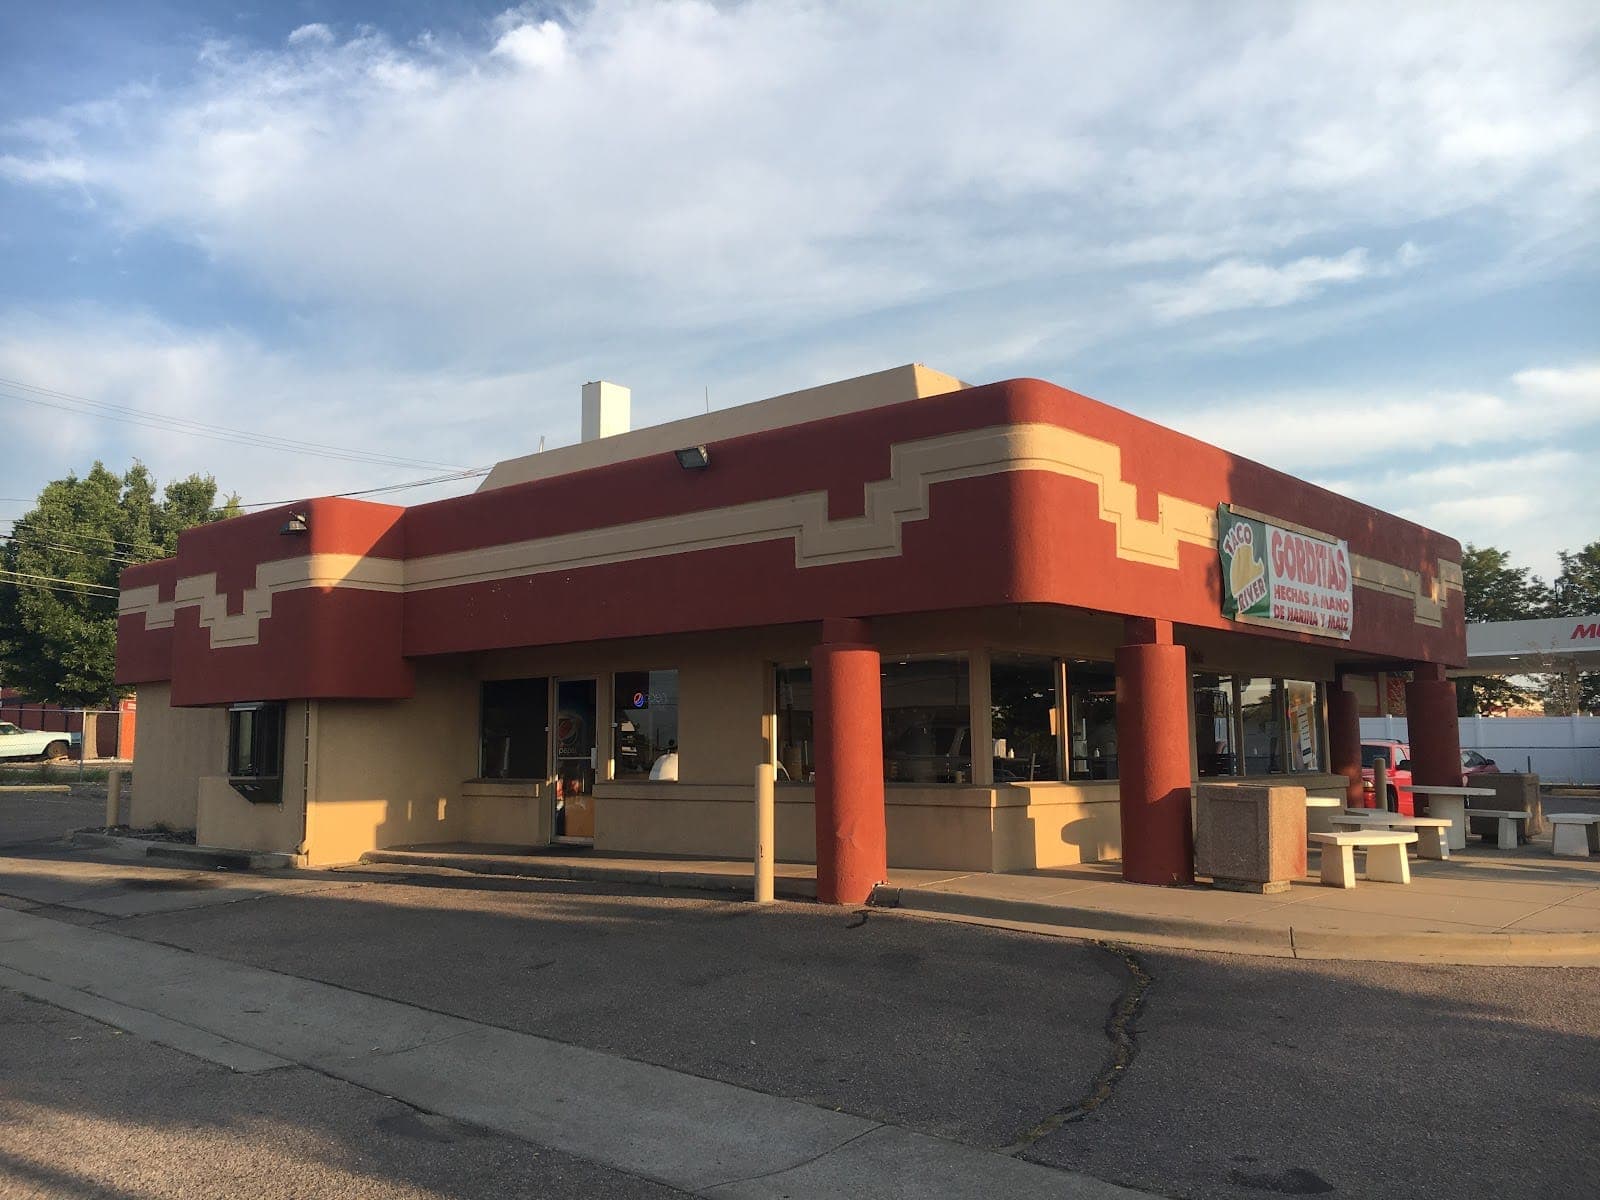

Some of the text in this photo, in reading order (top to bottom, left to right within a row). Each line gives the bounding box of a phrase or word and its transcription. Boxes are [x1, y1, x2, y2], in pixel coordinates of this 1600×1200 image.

[1224, 524, 1252, 556] TACO
[1272, 531, 1347, 592] GORDITAS
[1238, 577, 1266, 613] RIVER
[1274, 583, 1350, 613] HECHAS A MANO
[1274, 604, 1285, 619] DE
[1287, 606, 1318, 627] HARINA
[1320, 612, 1326, 628] Y
[1571, 624, 1600, 639] M
